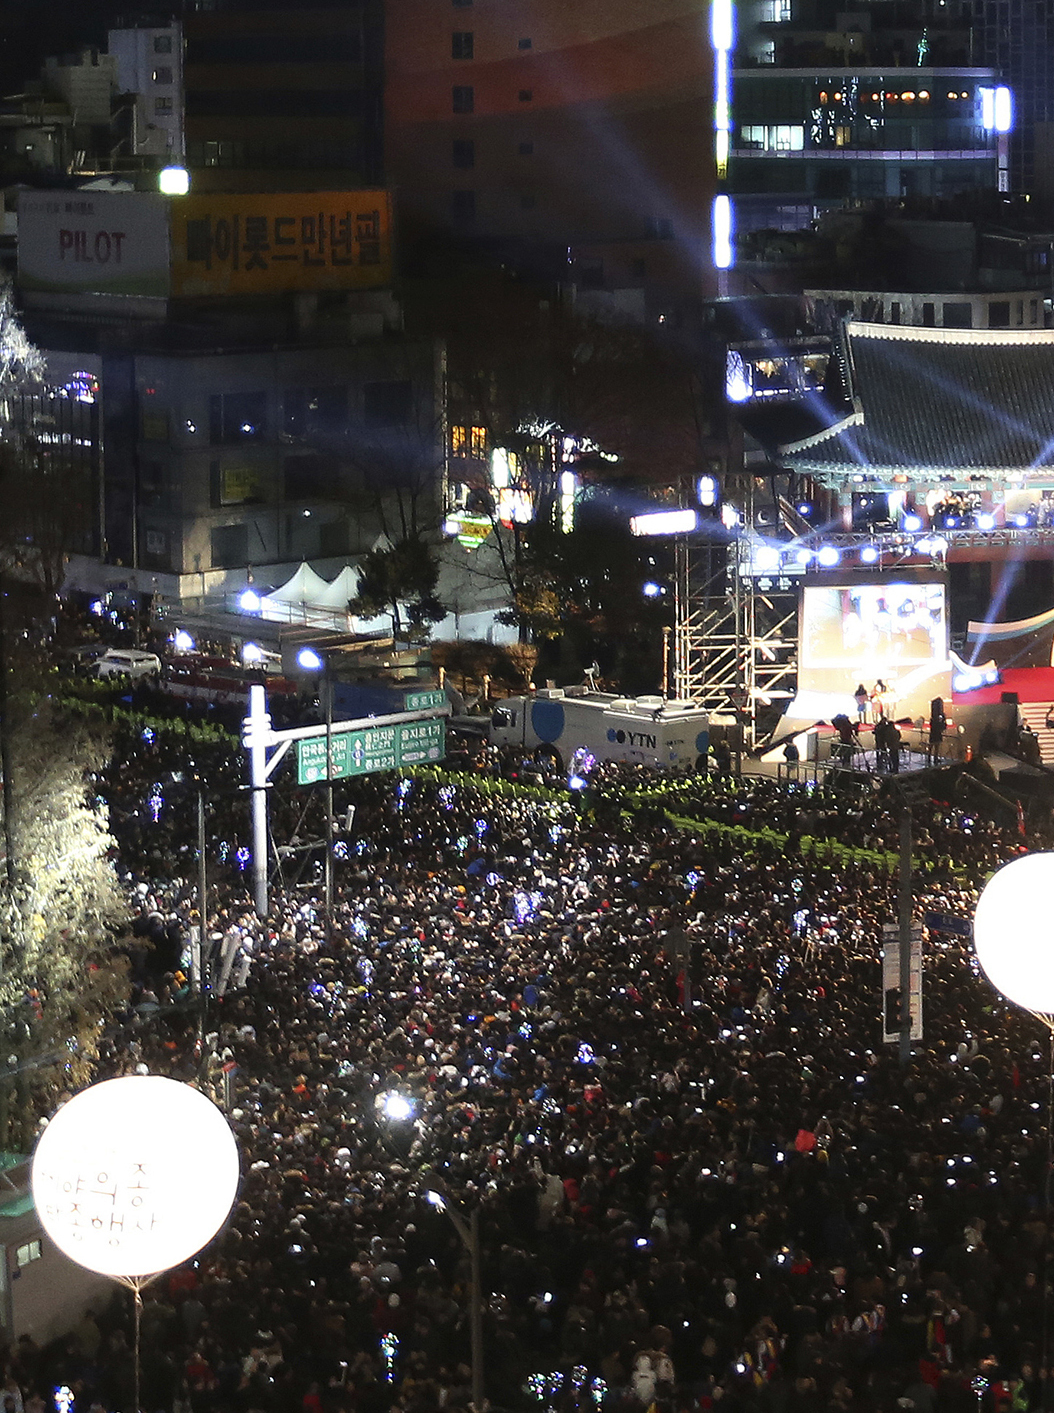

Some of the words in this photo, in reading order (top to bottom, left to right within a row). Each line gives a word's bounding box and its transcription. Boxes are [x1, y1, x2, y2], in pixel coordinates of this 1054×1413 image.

[59, 229, 126, 264] PILOT
[301, 739, 347, 758] 안국동거리
[626, 730, 657, 749] YTN
